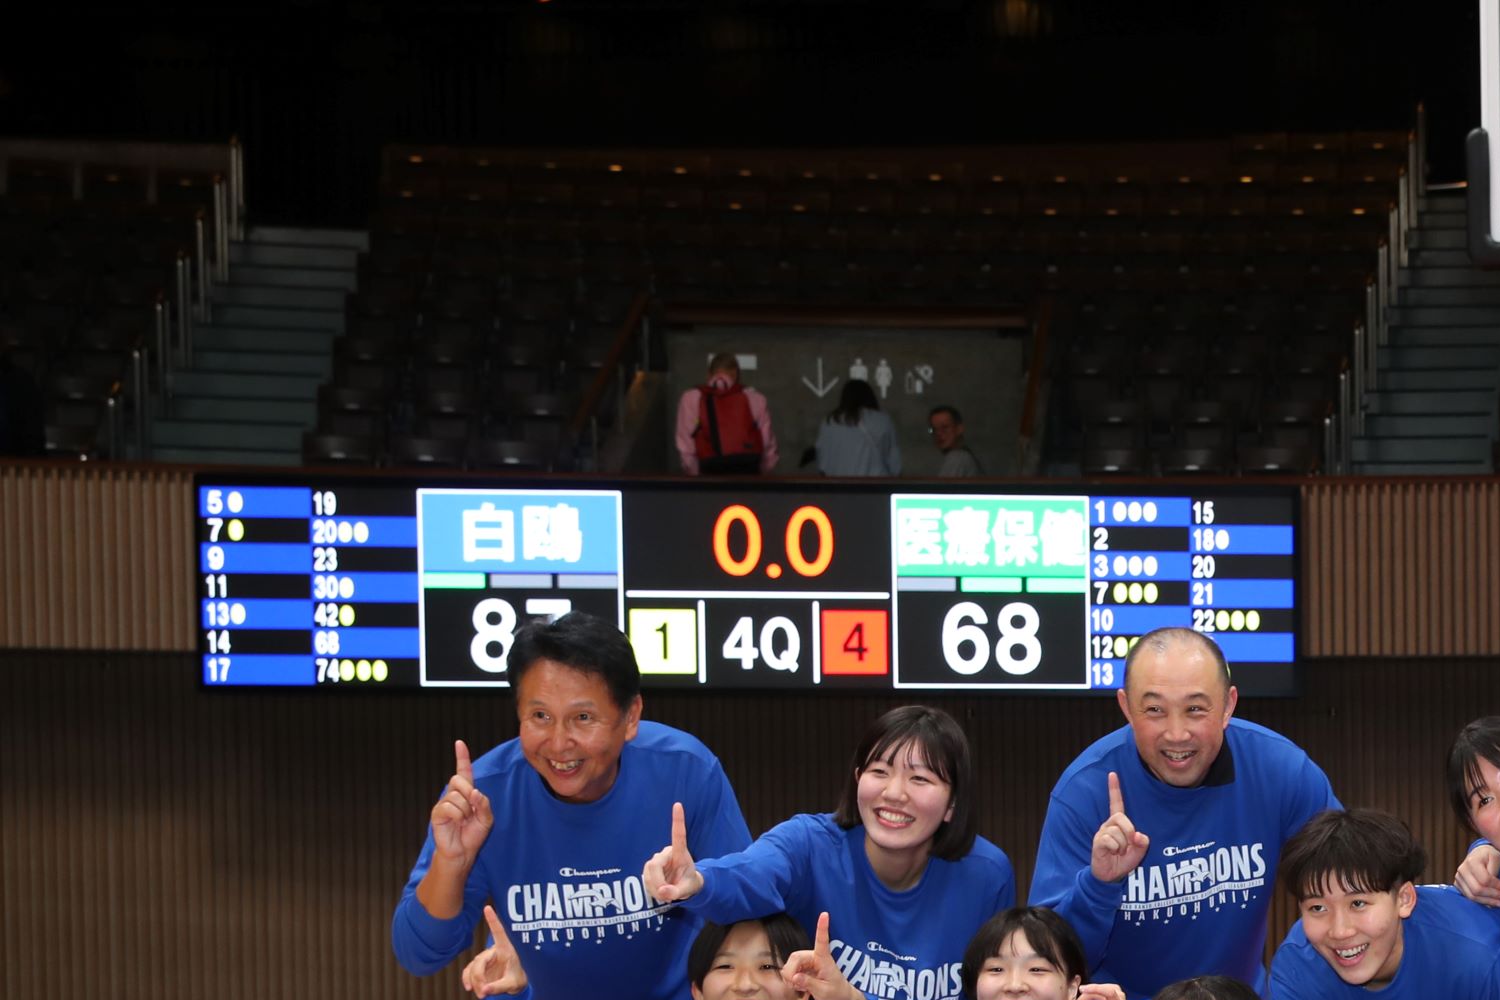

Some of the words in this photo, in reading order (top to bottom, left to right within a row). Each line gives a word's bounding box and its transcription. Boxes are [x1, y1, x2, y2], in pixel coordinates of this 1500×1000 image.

[207, 492, 222, 511] 5
[313, 492, 336, 515] 19
[1095, 502, 1104, 522] 1
[1193, 502, 1214, 524] 15
[207, 521, 223, 541] 7
[313, 520, 338, 543] 20
[713, 504, 834, 579] 0.0
[1094, 528, 1108, 550] 2
[1193, 529, 1216, 550] 18
[207, 546, 224, 568] 9
[313, 547, 338, 570] 23
[1094, 556, 1109, 577] 3
[1193, 556, 1215, 578] 20
[205, 575, 227, 597] 11
[314, 575, 339, 598] 30
[1095, 582, 1109, 603] 7
[1193, 583, 1213, 604] 21
[206, 603, 230, 626] 13
[314, 603, 340, 626] 42
[1092, 609, 1114, 630] 10
[1193, 610, 1215, 631] 22
[207, 631, 231, 654] 14
[654, 622, 668, 660] 1
[722, 616, 801, 674] 4Q
[843, 622, 868, 661] 4
[940, 602, 1042, 675] 68
[1092, 636, 1114, 659] 12
[207, 658, 230, 681] 17
[316, 660, 341, 682] 74
[1091, 664, 1114, 686] 13
[1163, 841, 1216, 857] Champion
[559, 867, 622, 878] Champion
[1122, 843, 1266, 902] HAMPIONS
[1124, 902, 1200, 920] HAKUOH
[1209, 890, 1256, 908] UNIV.
[522, 926, 605, 943] HAKUOH
[617, 915, 671, 935] UNIV.
